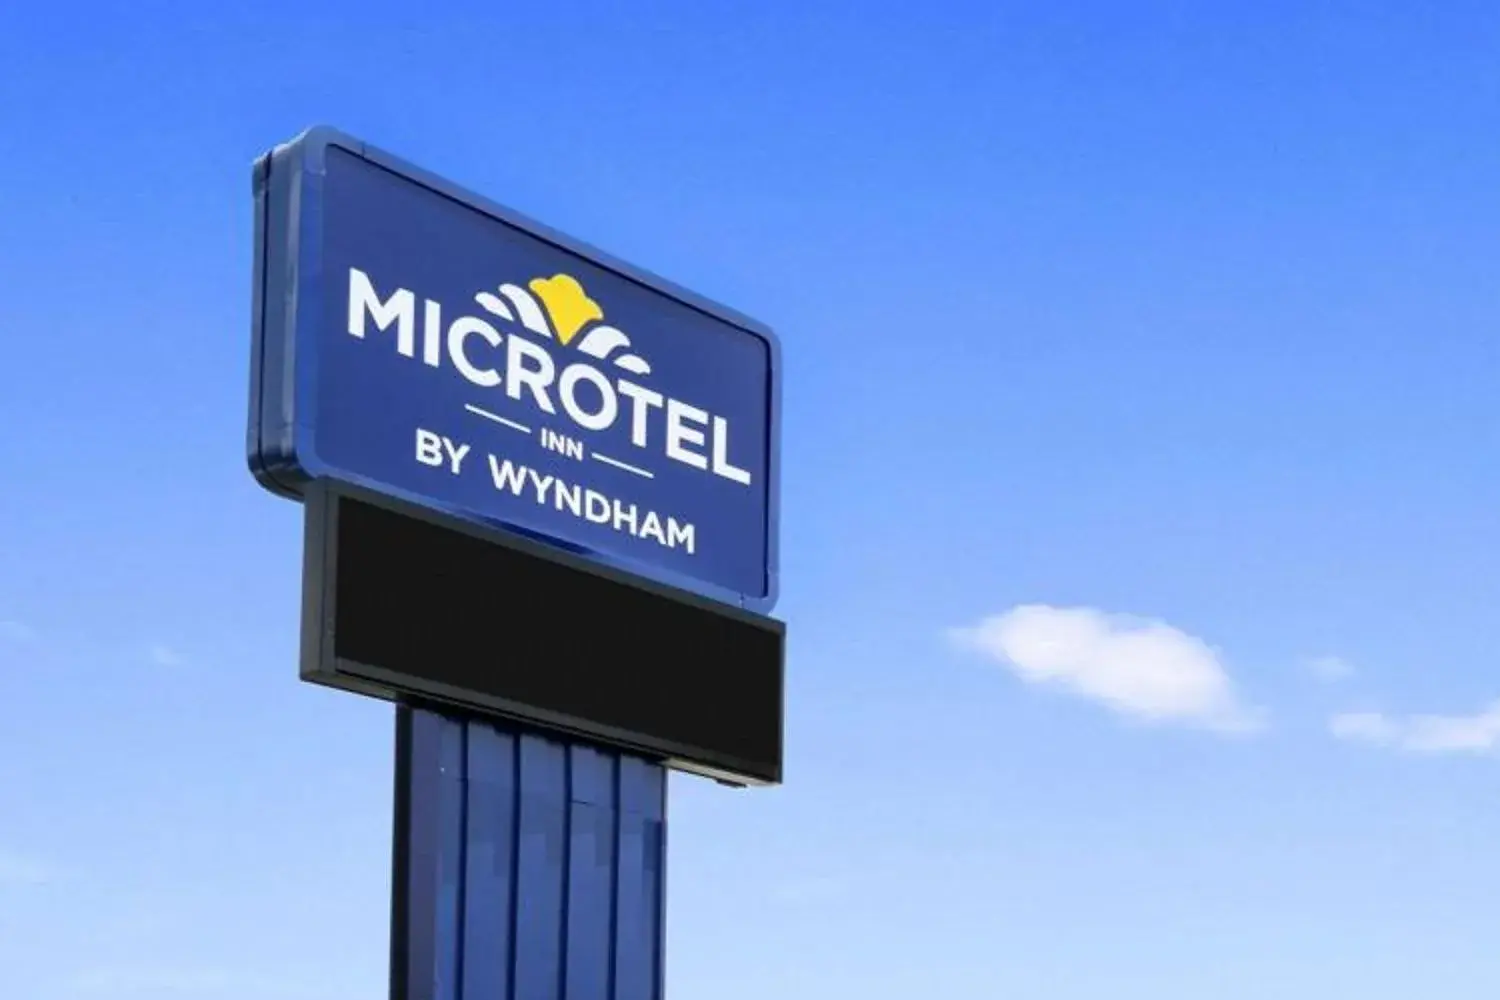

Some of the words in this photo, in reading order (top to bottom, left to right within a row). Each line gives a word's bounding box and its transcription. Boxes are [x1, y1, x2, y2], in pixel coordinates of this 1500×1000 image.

[347, 267, 751, 485] MICROTEL
[415, 428, 471, 474] BY
[488, 454, 695, 554] WYNDHAM
[541, 427, 584, 461] INN
